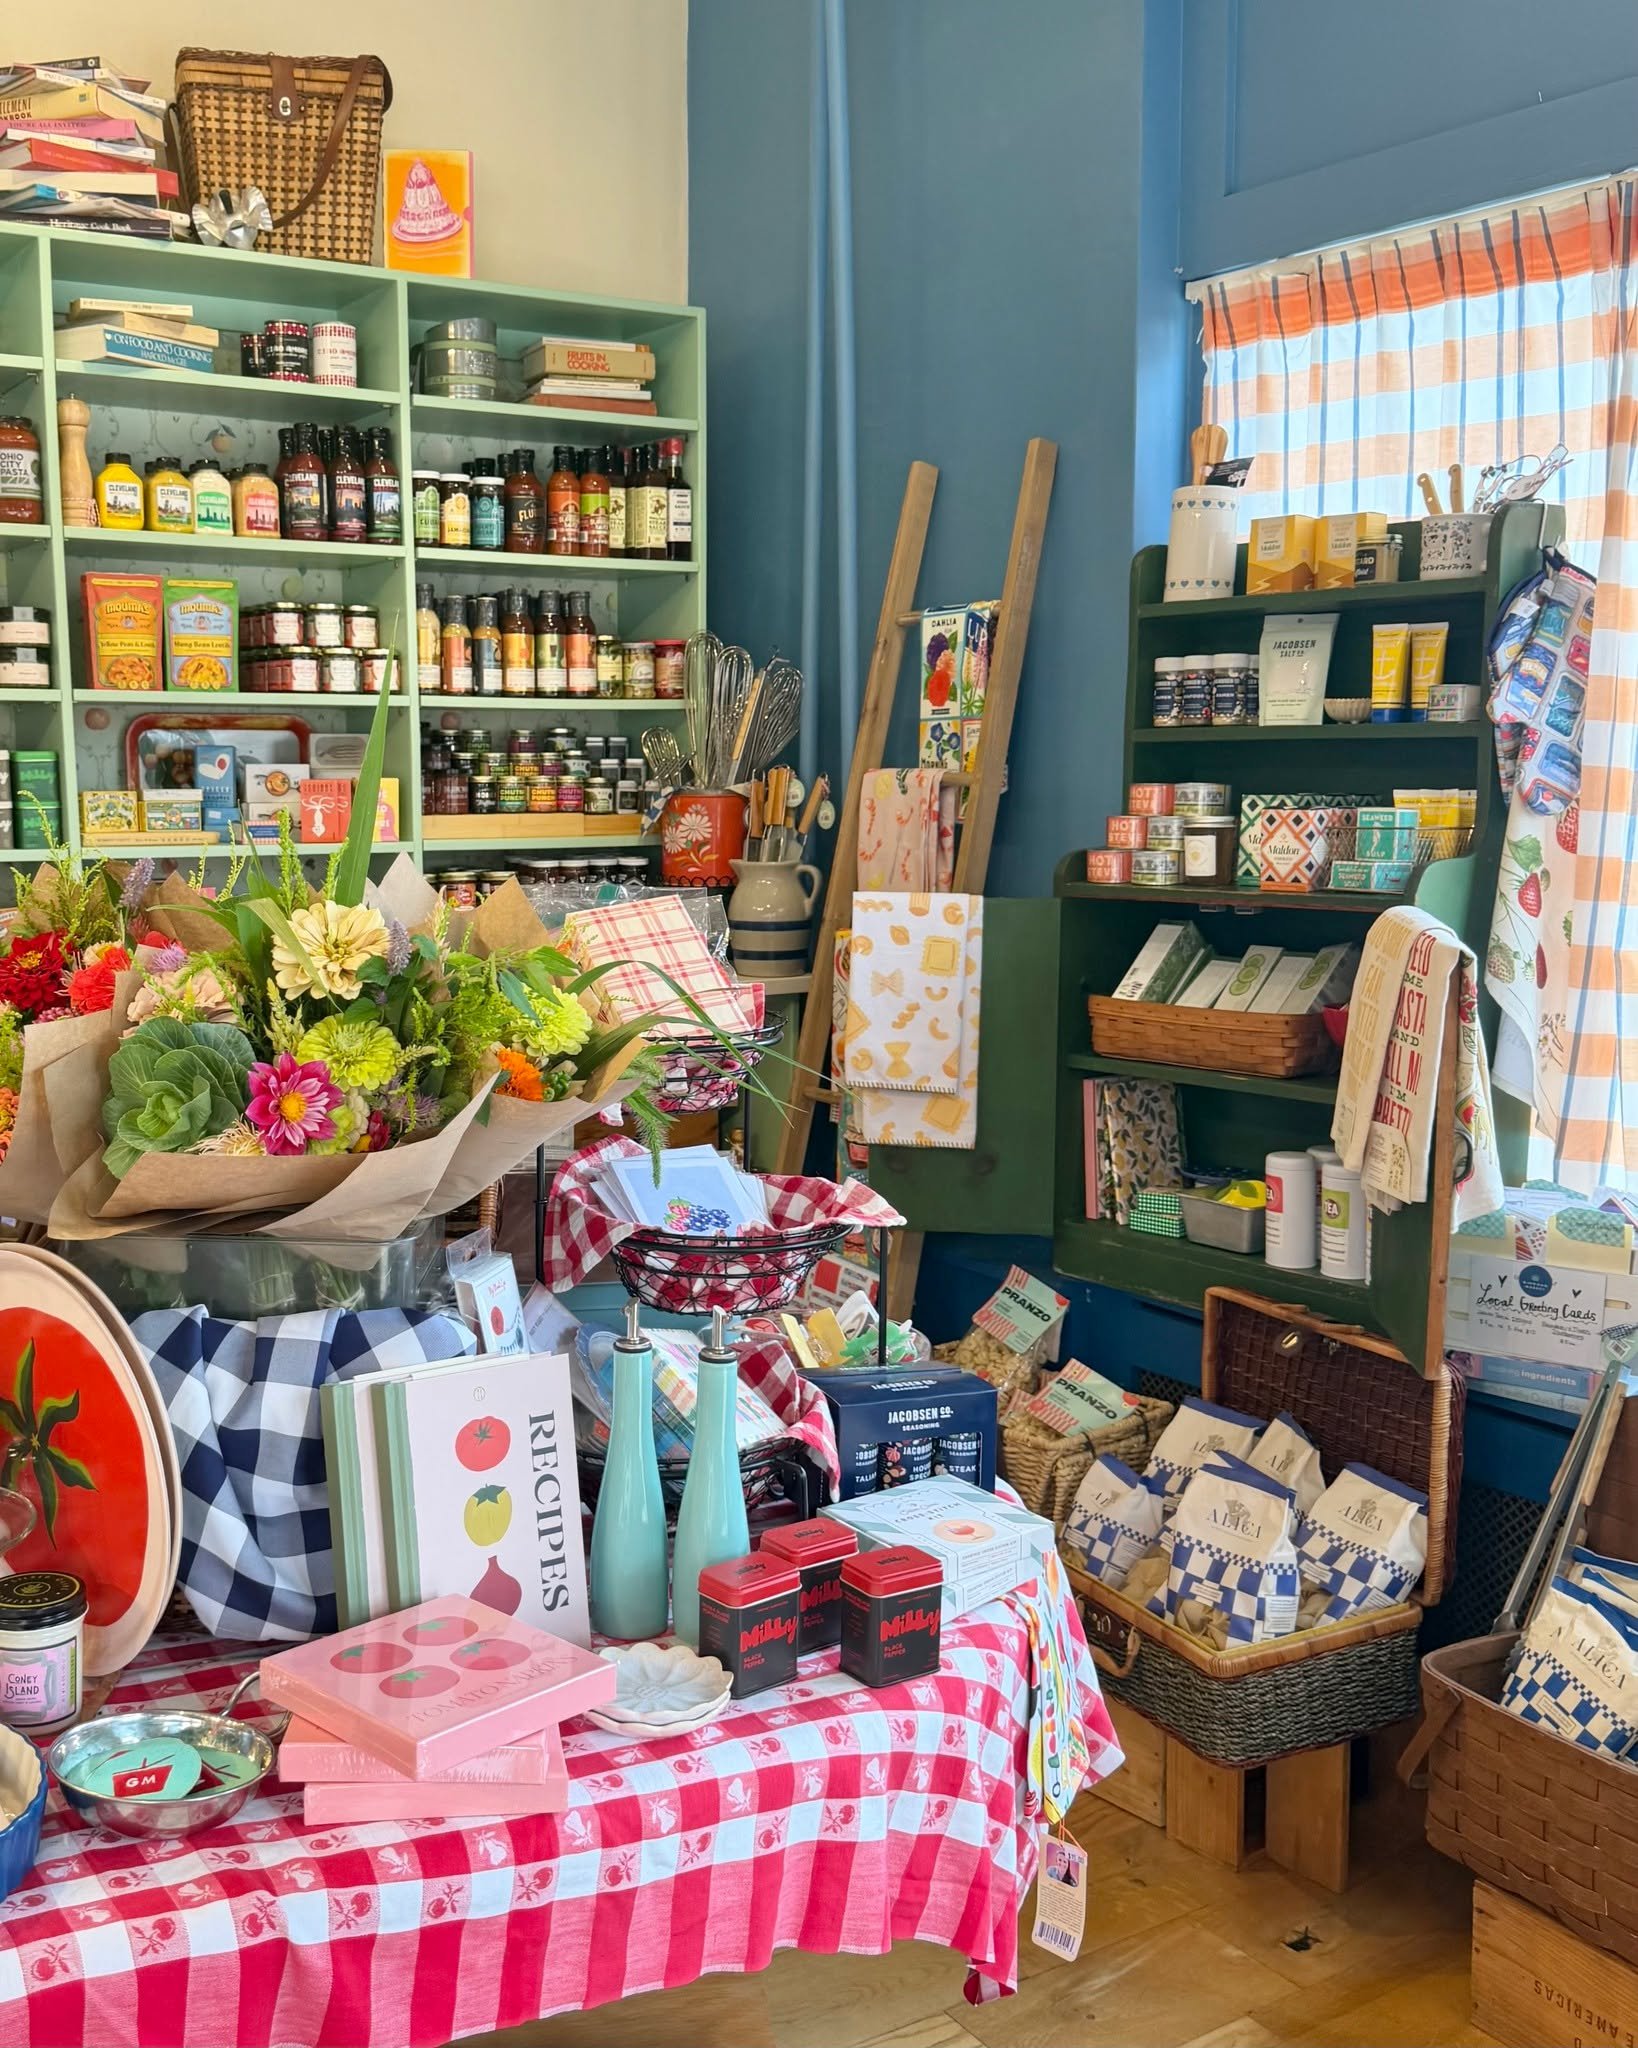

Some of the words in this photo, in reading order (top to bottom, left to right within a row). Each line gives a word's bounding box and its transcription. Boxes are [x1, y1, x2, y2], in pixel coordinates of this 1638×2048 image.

[0, 98, 33, 116] LEMENT
[113, 335, 130, 347] ON
[128, 336, 154, 351] FOOD
[152, 341, 173, 354] AND
[172, 345, 213, 364] COOKING
[140, 350, 167, 364] HAROLD
[567, 350, 595, 362] FRUITS
[596, 353, 606, 363] IN
[567, 360, 610, 373] COOKING
[0, 453, 23, 461] OHIO
[0, 461, 21, 469] CITY
[1, 468, 29, 476] PASTA
[108, 484, 138, 493] CLEVELAND
[159, 488, 189, 498] CLEVELAND
[931, 617, 957, 628] DAHLIA
[1272, 639, 1317, 650] JACOBSEN
[1280, 650, 1296, 658] SALT
[1361, 813, 1394, 822] SEAWEED
[1267, 843, 1301, 857] Maldon
[1405, 972, 1423, 988] ME
[1392, 1030, 1420, 1048] AND
[1475, 1282, 1514, 1307] Local
[1000, 1286, 1052, 1323] PRANZO
[1521, 1369, 1577, 1387] ingredients
[1055, 1377, 1118, 1420] PRANZO
[887, 1408, 939, 1424] JACOBSEN
[939, 1405, 954, 1419] CO.
[902, 1421, 940, 1432] SEASONING
[939, 1439, 977, 1450] JACOBSEN
[949, 1465, 977, 1473] STEAK
[529, 1409, 570, 1612] RECIPES
[801, 1578, 843, 1613] Mill
[880, 1608, 940, 1643] Milly
[739, 1615, 798, 1653] Milly
[883, 1642, 903, 1653] BLACK
[884, 1647, 906, 1659] PEPPER
[743, 1652, 763, 1664] BLACK
[743, 1658, 766, 1670] PEPPER
[8, 1673, 39, 1685] CONEY
[4, 1683, 40, 1699] ISLAND
[125, 1774, 157, 1788] GM
[1533, 1979, 1620, 2040] AMERICAS
